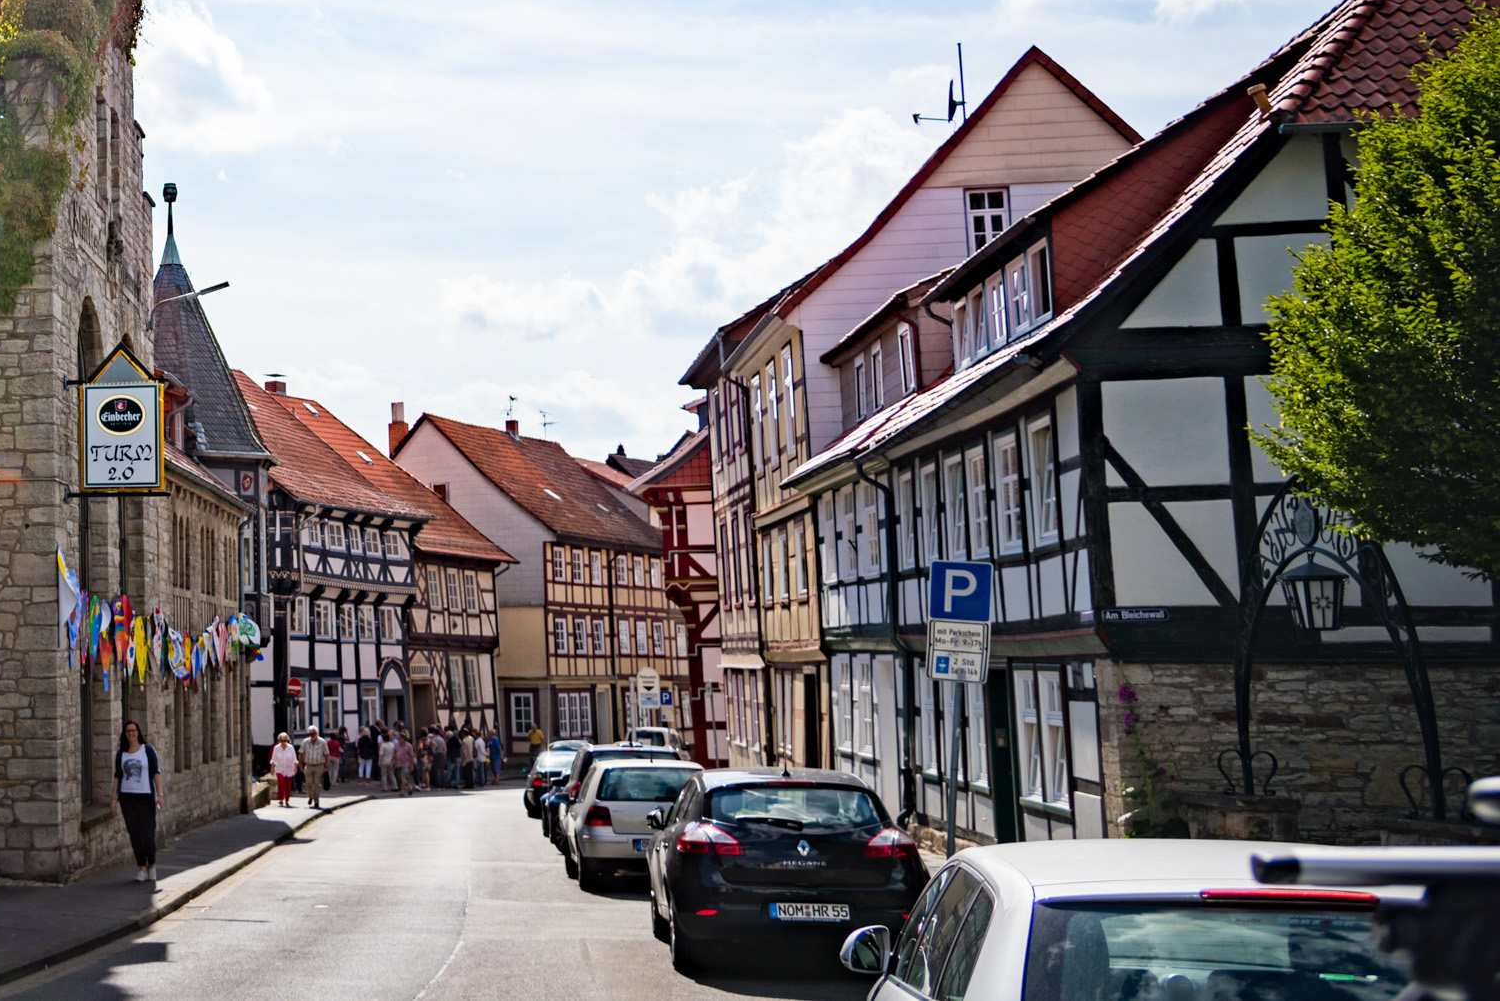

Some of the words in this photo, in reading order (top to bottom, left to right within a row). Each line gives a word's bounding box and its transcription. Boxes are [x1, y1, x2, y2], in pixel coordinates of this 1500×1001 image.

[90, 444, 153, 464] TURM
[108, 466, 135, 480] 2.0
[944, 569, 977, 612] P
[1105, 611, 1118, 619] Am
[1121, 610, 1165, 619] Bleichewall
[949, 628, 981, 638] Parkschein
[662, 692, 670, 703] P
[778, 904, 804, 916] NOM
[812, 905, 829, 917] HR
[832, 905, 849, 918] 55
